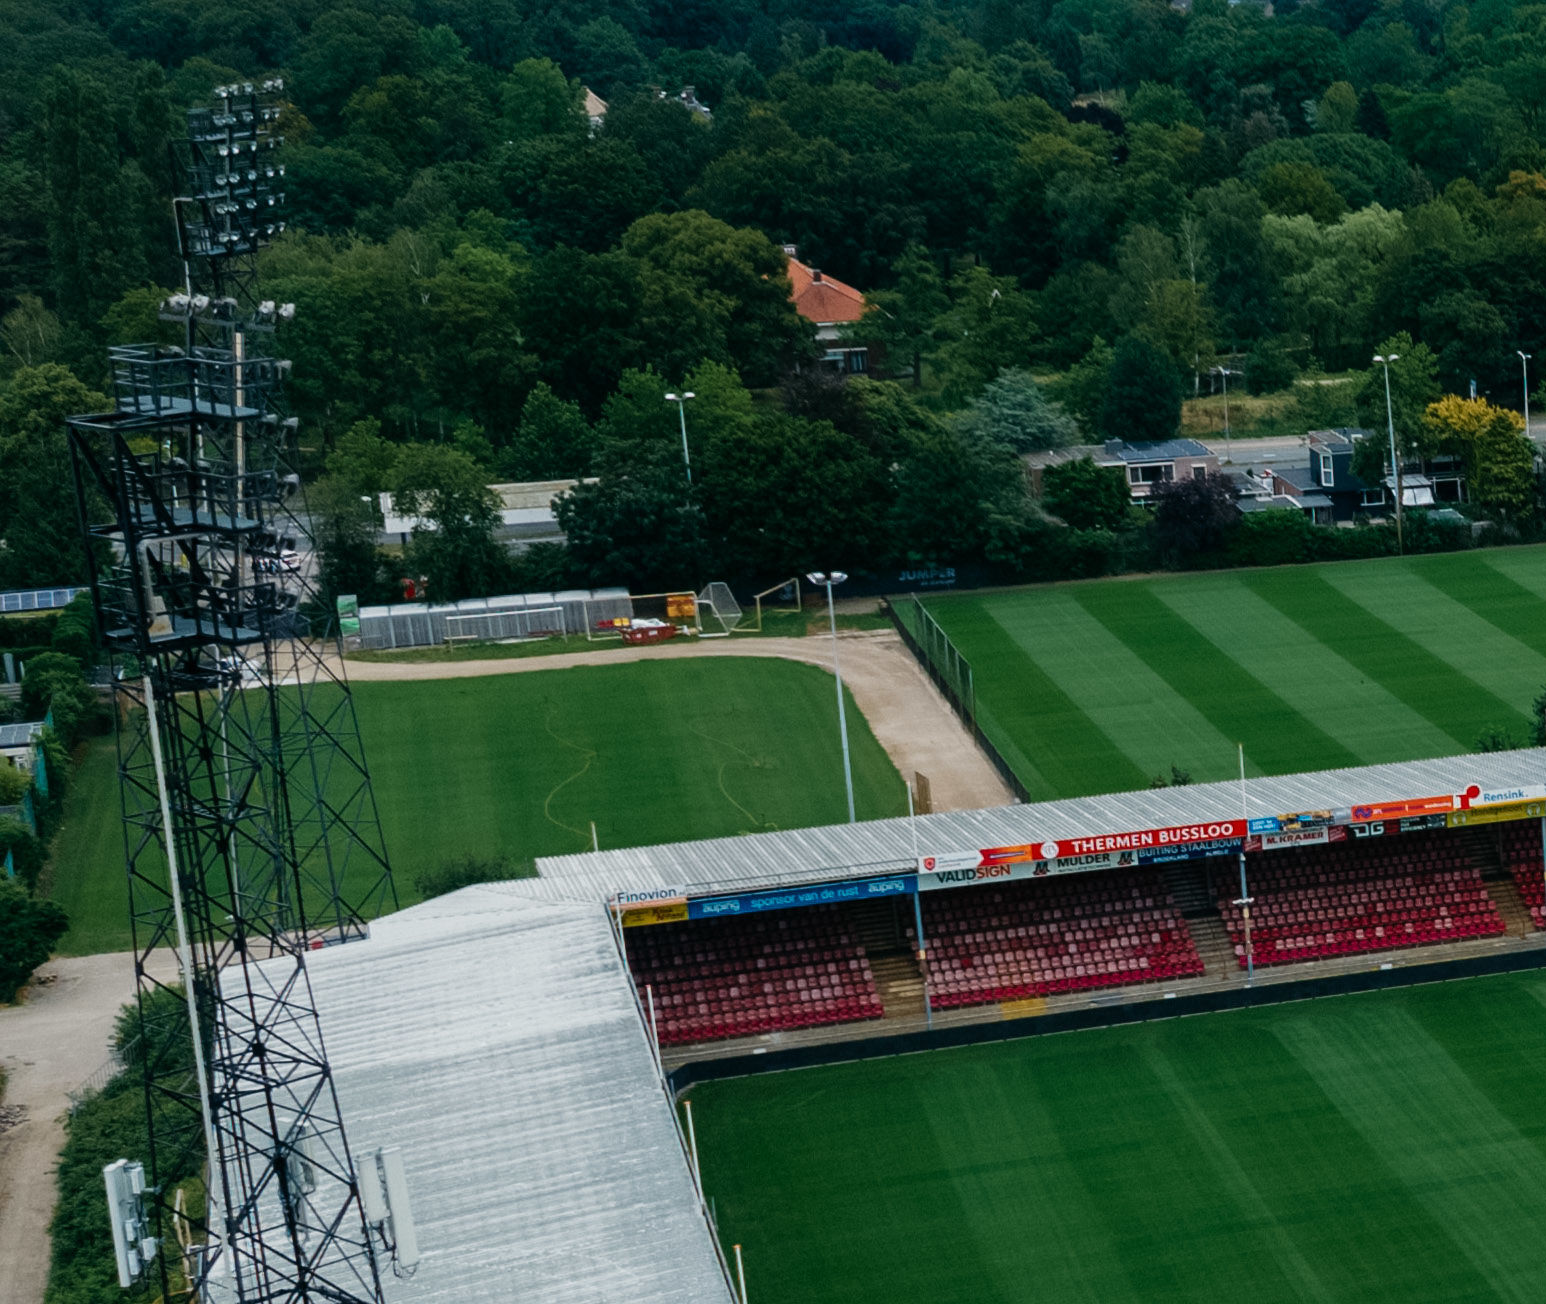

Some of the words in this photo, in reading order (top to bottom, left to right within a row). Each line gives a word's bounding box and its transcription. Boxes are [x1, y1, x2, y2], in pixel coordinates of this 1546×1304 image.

[1483, 790, 1530, 803] Rensink.
[1071, 832, 1154, 854] THERMEN
[1158, 822, 1235, 844] BUSSLOO
[1178, 837, 1243, 853] STAALBOUW
[1057, 852, 1111, 868] MULDER
[936, 863, 1012, 884] VALIDSIGN
[867, 880, 905, 894] auping
[616, 887, 677, 904] Finovion
[702, 899, 741, 914] auping
[750, 893, 796, 910] sponsor
[797, 891, 820, 903] van
[821, 888, 834, 900] de
[837, 885, 859, 898] rust
